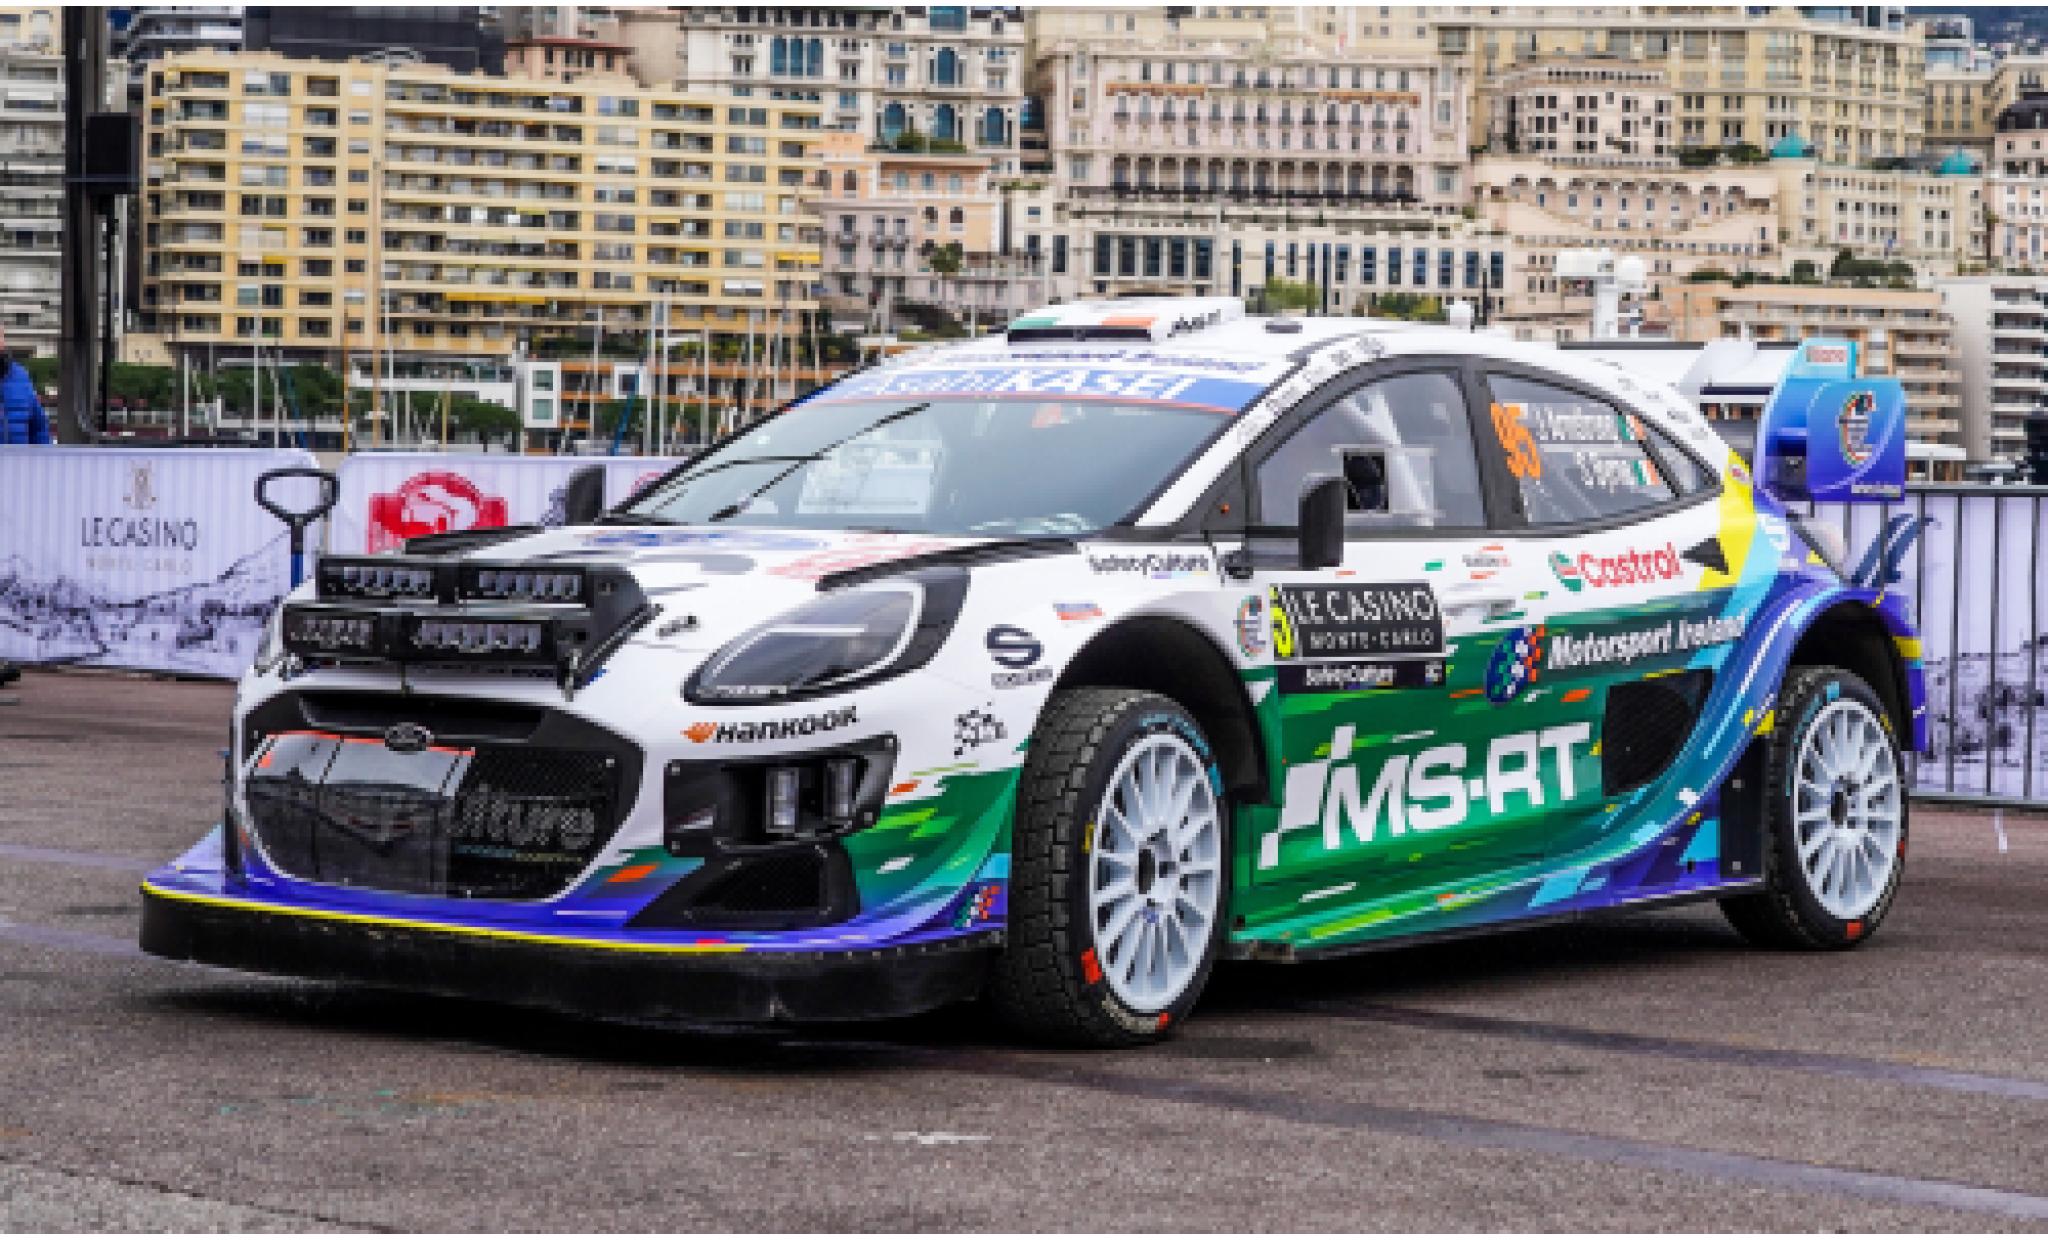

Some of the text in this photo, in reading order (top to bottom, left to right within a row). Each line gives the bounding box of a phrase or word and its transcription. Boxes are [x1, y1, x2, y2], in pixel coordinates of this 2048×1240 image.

[1490, 402, 1542, 479] 95
[106, 517, 198, 551] CASINO
[1577, 541, 1683, 588] Castrol
[1327, 589, 1434, 624] CASINO
[1547, 608, 1747, 670] Motorsport Ireland
